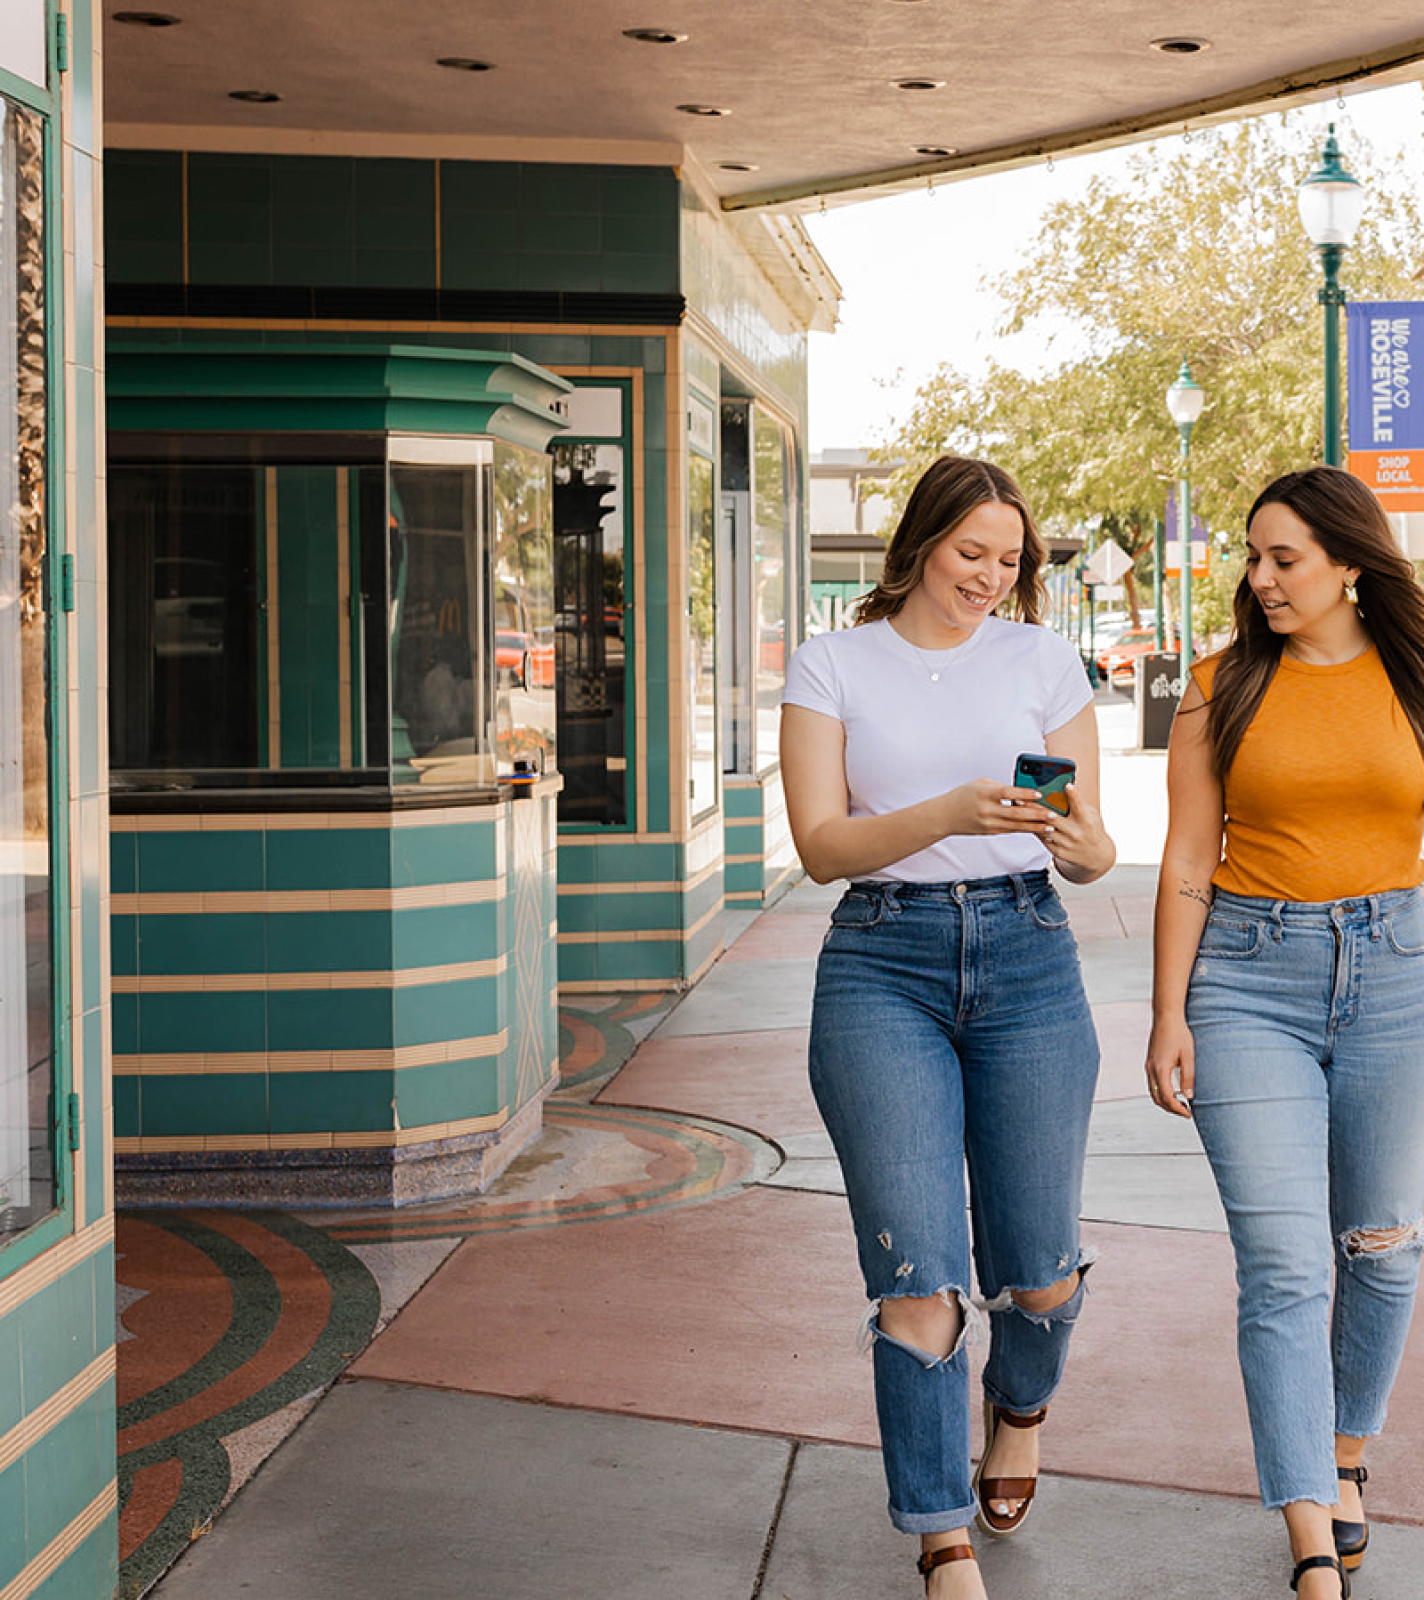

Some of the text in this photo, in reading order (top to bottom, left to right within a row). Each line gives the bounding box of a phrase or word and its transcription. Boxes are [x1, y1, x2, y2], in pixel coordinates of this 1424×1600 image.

[1391, 318, 1411, 389] We are
[1370, 318, 1393, 443] ROSEVILLE
[1375, 470, 1413, 483] LOCAL
[1377, 455, 1411, 469] SHOP
